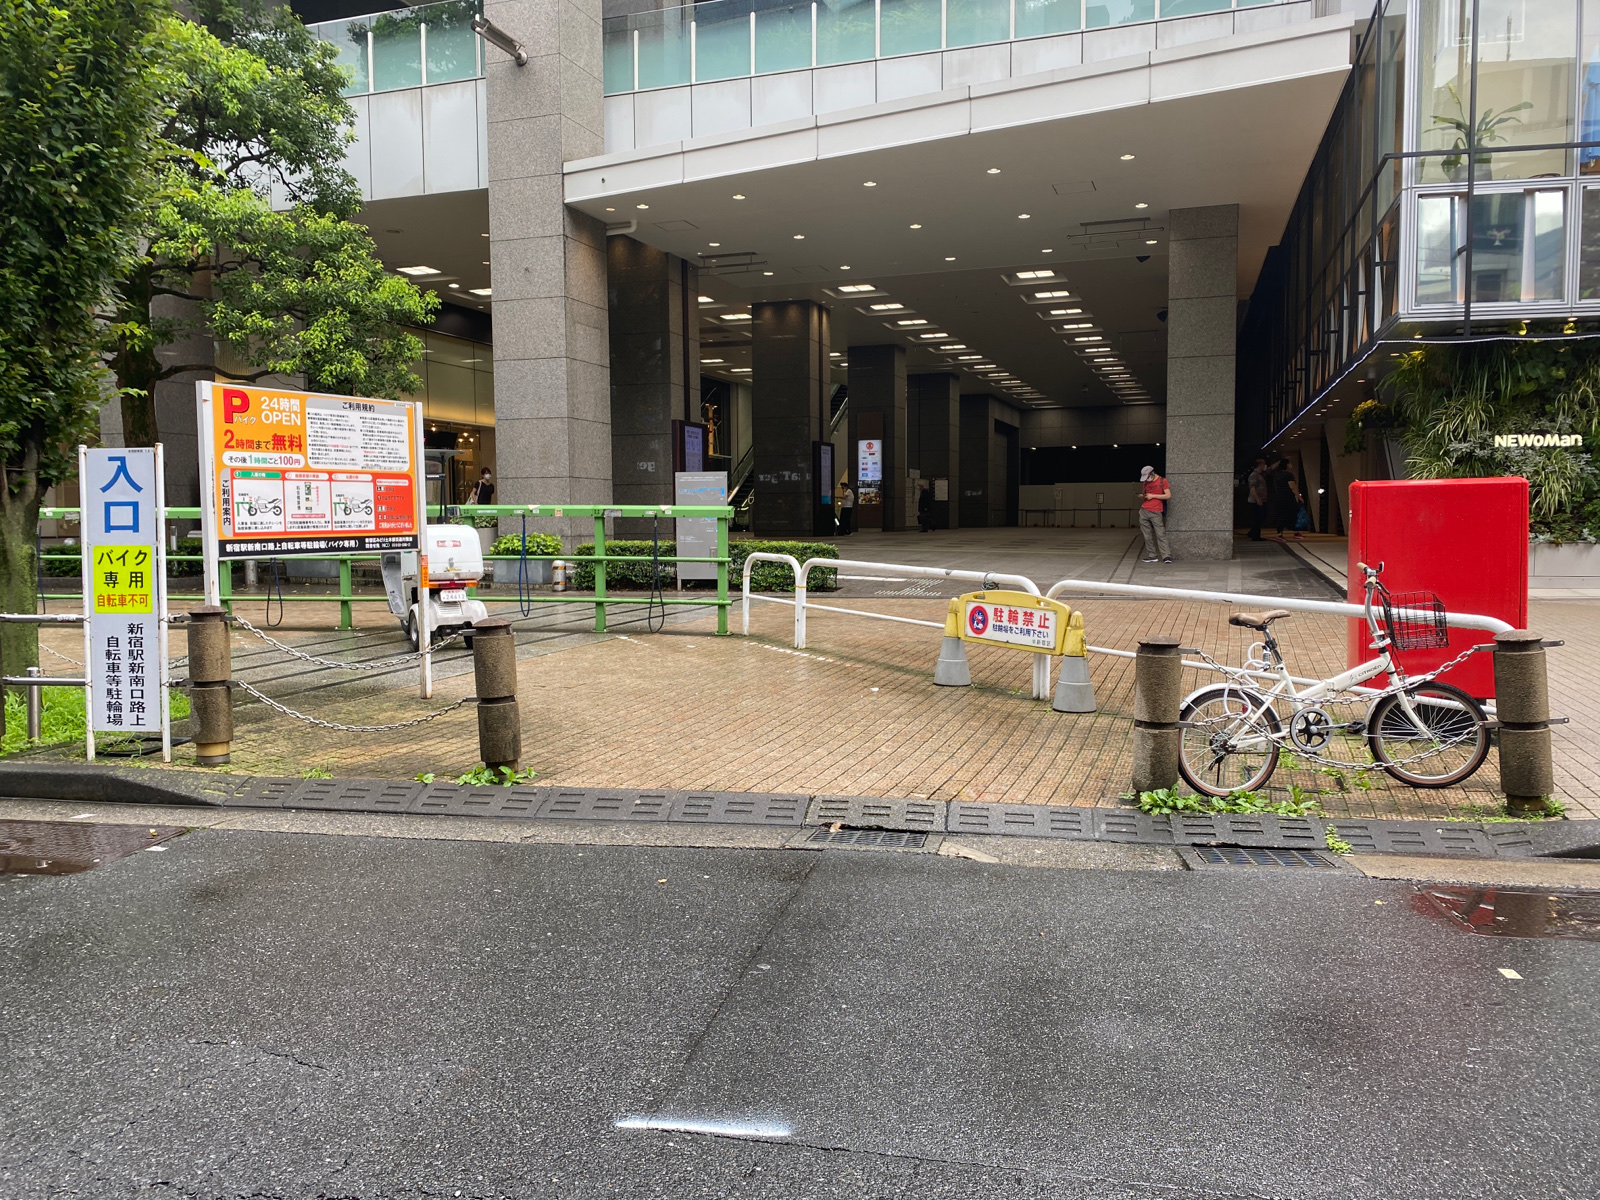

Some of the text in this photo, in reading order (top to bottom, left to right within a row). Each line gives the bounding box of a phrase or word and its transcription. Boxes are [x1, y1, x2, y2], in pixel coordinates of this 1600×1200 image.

[223, 388, 250, 424] P
[260, 396, 301, 412] 24時間
[342, 401, 376, 413] ご利用規約
[234, 416, 257, 425] バイク
[261, 410, 301, 426] OPEN
[223, 429, 303, 452] 2時間まで無料
[1494, 433, 1583, 447] NEWoMan
[99, 456, 144, 534] 入口
[222, 480, 231, 526] ご利用案内
[97, 549, 148, 567] バイク
[103, 571, 144, 589] 専用
[97, 593, 149, 608] 自転車不可
[993, 607, 1050, 629] 駐輪禁止
[992, 623, 1049, 639] 駐輪場をご利用下さい
[105, 636, 124, 726] 自転車等駐輪場
[127, 622, 147, 727] 新宿駅新南口路上
